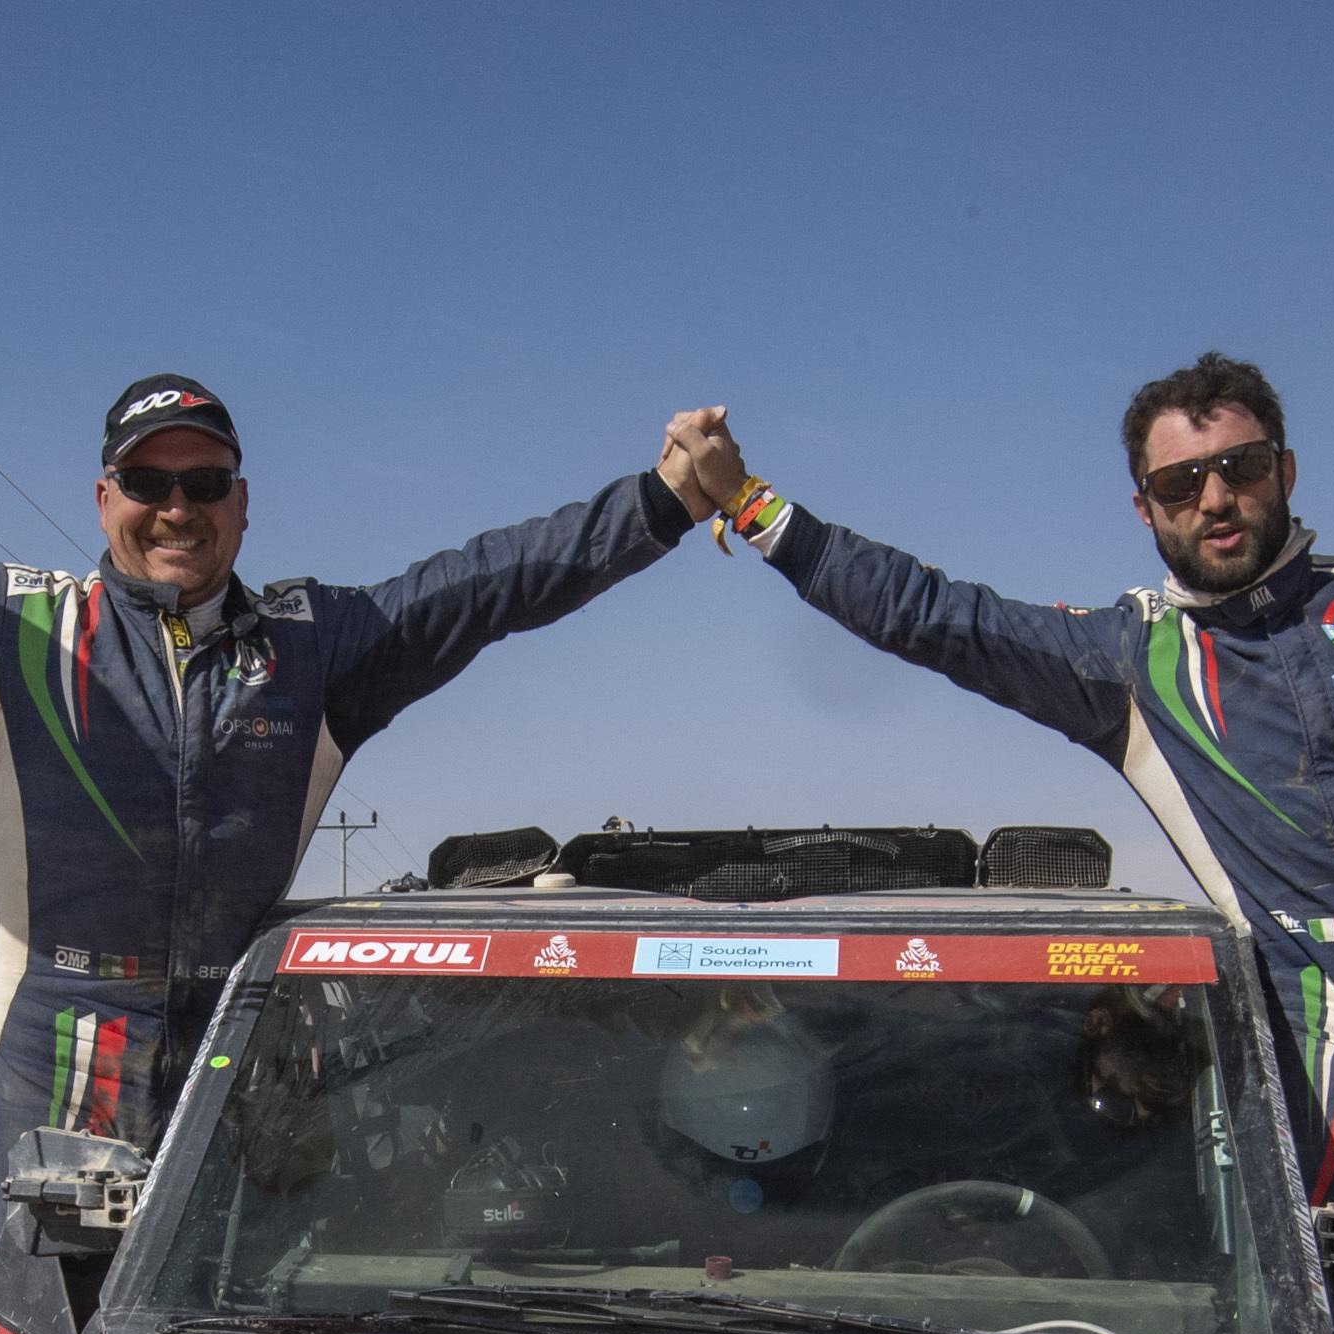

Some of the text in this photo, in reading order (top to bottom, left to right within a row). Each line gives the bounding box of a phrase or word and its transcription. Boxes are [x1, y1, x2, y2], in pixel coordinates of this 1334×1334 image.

[171, 616, 188, 648] OMP
[244, 741, 274, 749] ONLUS
[299, 941, 475, 965] MOTUL
[702, 945, 769, 956] Soudah
[1047, 942, 1145, 954] DREAM.
[54, 948, 91, 970] OMP
[533, 956, 578, 969] DAKAR
[700, 957, 814, 970] Development
[1048, 953, 1124, 965] DARE.
[539, 967, 570, 975] 2022
[896, 959, 943, 972] DAKAR
[1048, 965, 1139, 976] LIVE IT.
[903, 971, 936, 979] 2022
